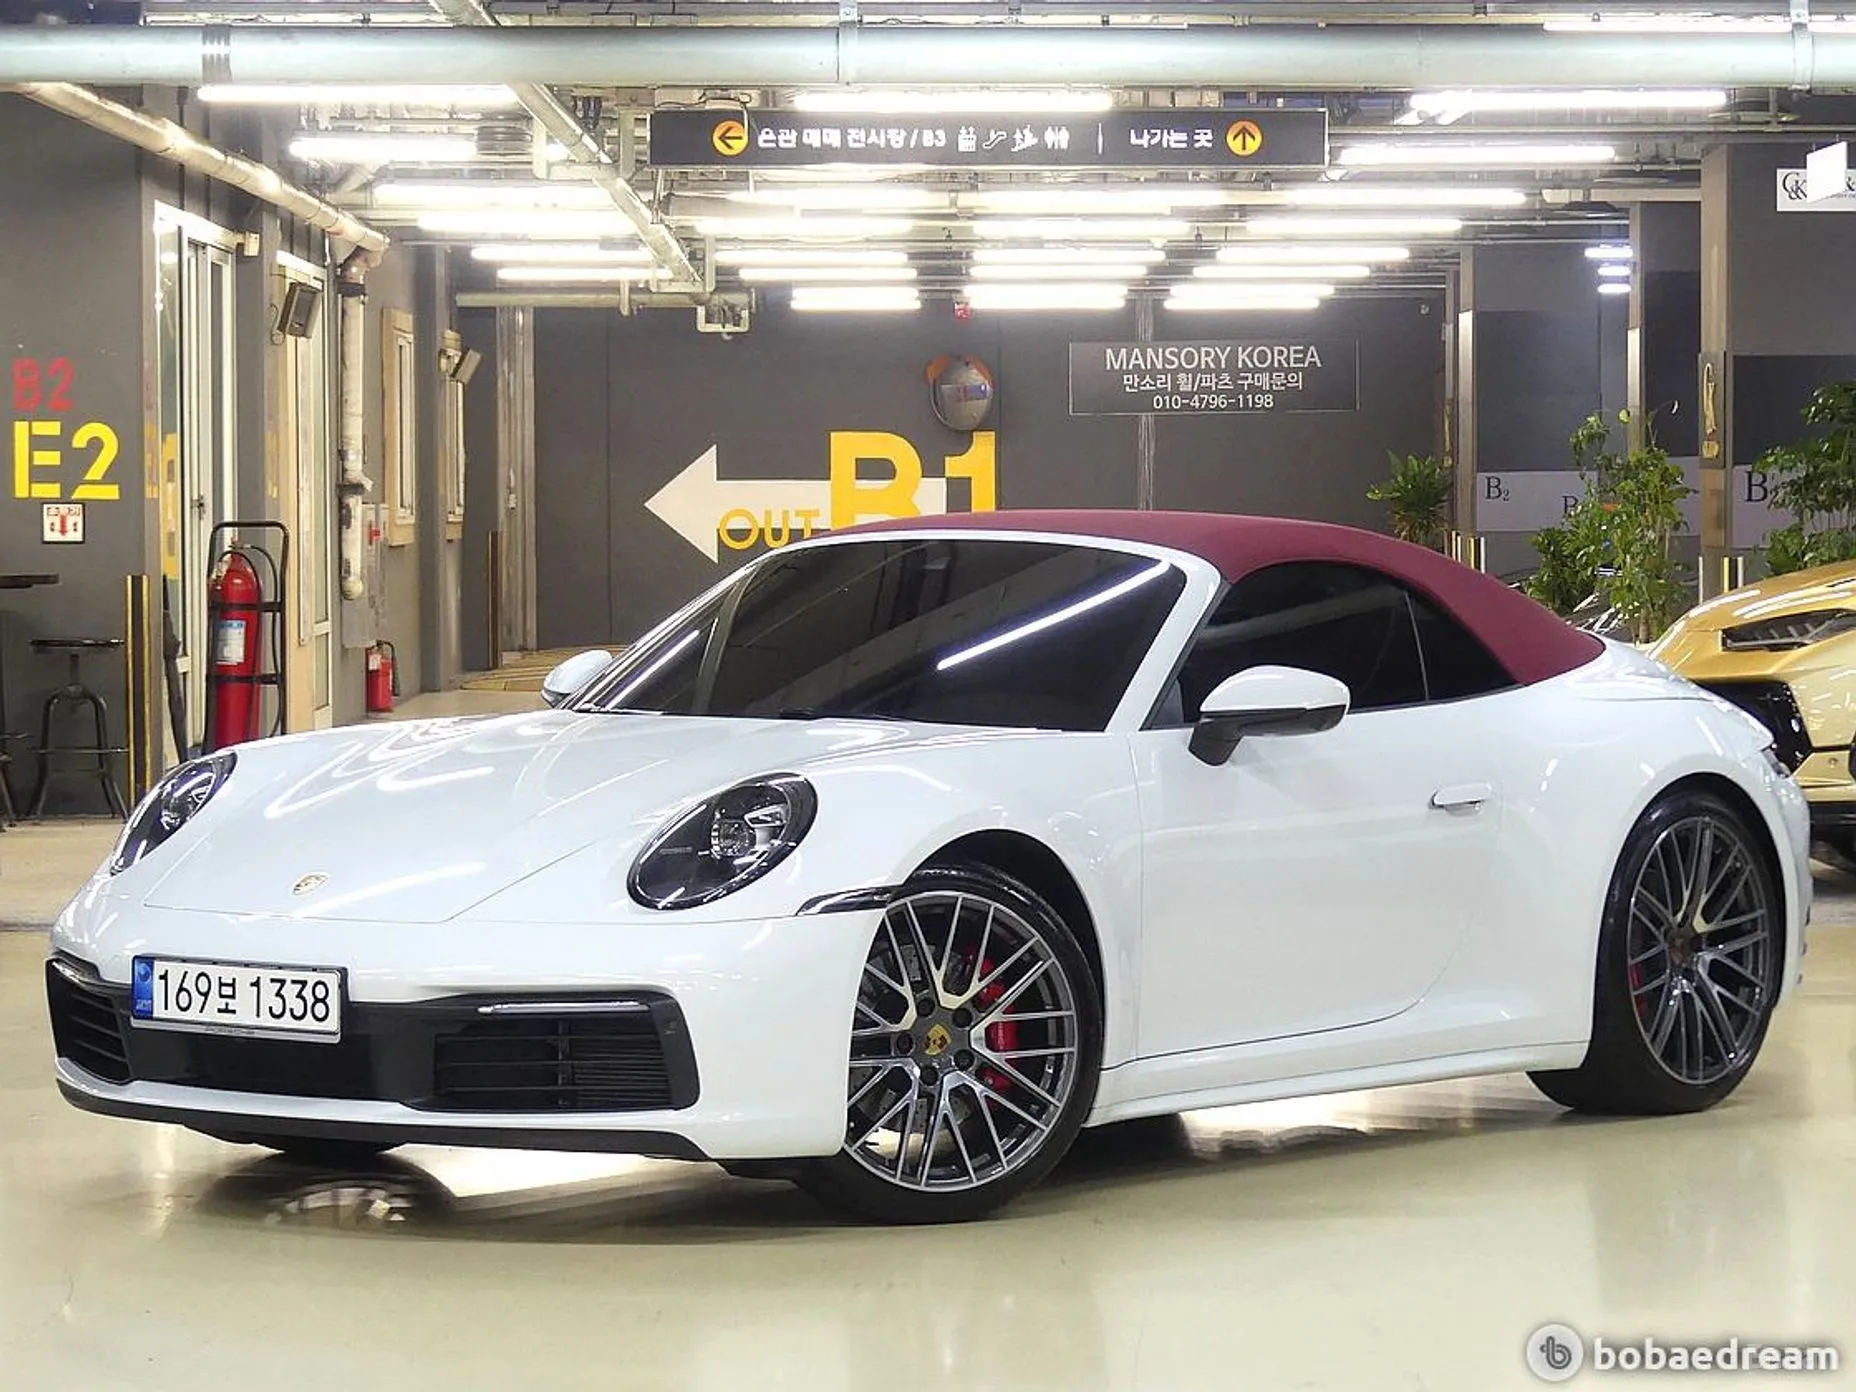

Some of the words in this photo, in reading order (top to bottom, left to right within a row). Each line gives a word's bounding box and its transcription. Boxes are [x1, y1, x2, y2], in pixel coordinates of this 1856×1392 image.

[802, 128, 841, 149] 매매
[847, 128, 907, 149] 전시장
[922, 129, 947, 148] B3
[1130, 129, 1188, 149] 나가는
[1193, 129, 1213, 149] 곳
[1105, 347, 1231, 371] MANSORY
[1238, 345, 1322, 369] KOREA
[13, 358, 74, 410] B2
[1123, 373, 1172, 392] 만소리
[1237, 372, 1303, 391] 구매문의
[1153, 394, 1274, 409] 010-4796-1198
[13, 421, 121, 500] E2
[830, 431, 995, 531] B1
[1485, 476, 1510, 501] B2
[719, 509, 820, 550] OUT
[158, 969, 237, 1014] 169보
[250, 976, 330, 1022] 1338
